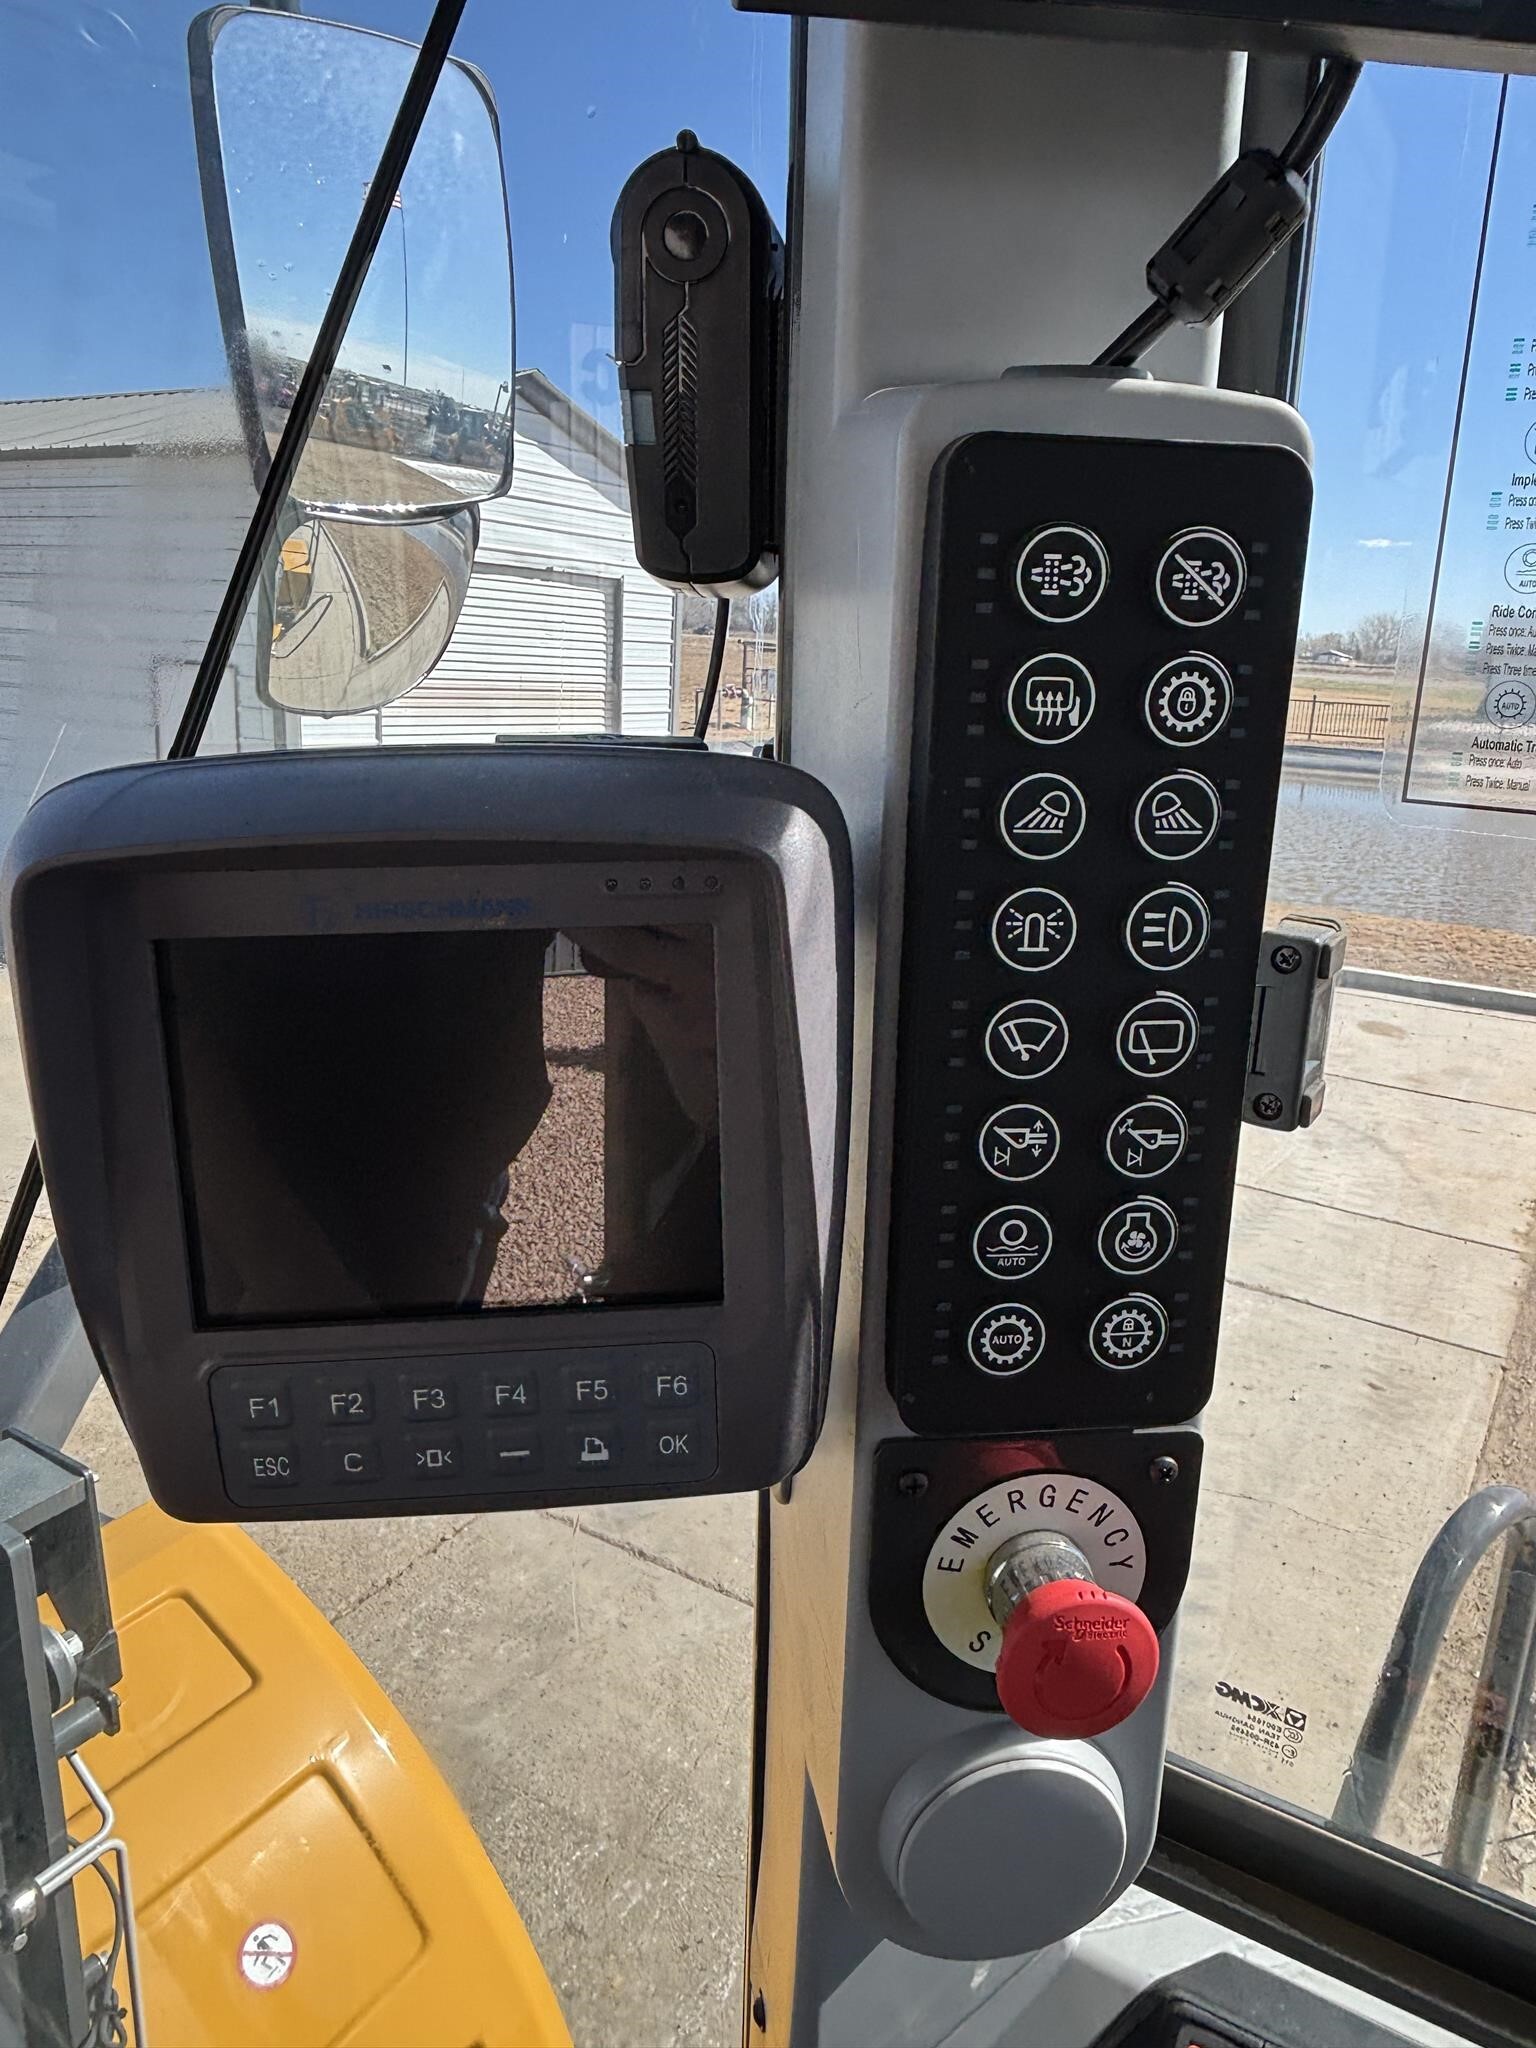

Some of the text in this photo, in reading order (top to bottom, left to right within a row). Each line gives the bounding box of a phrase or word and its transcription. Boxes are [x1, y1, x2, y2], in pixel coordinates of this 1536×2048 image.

[1491, 604, 1515, 618] Ride
[1489, 624, 1507, 637] Press
[1486, 642, 1504, 655] Press
[1482, 662, 1501, 675] Press
[1501, 702, 1520, 711] AUTO
[1471, 736, 1523, 752] Automatic
[1469, 753, 1488, 767] Press
[1465, 774, 1484, 788] Press
[997, 1256, 1027, 1268] AUTO
[991, 1333, 1024, 1346] AUTO
[1122, 1336, 1133, 1348] N
[248, 1374, 689, 1419] F1 F2 F3 F4 F5 F6
[253, 1434, 690, 1478] ESC C OK
[936, 1484, 1134, 1574] EMERGENCY
[1053, 1615, 1130, 1631] Schneider
